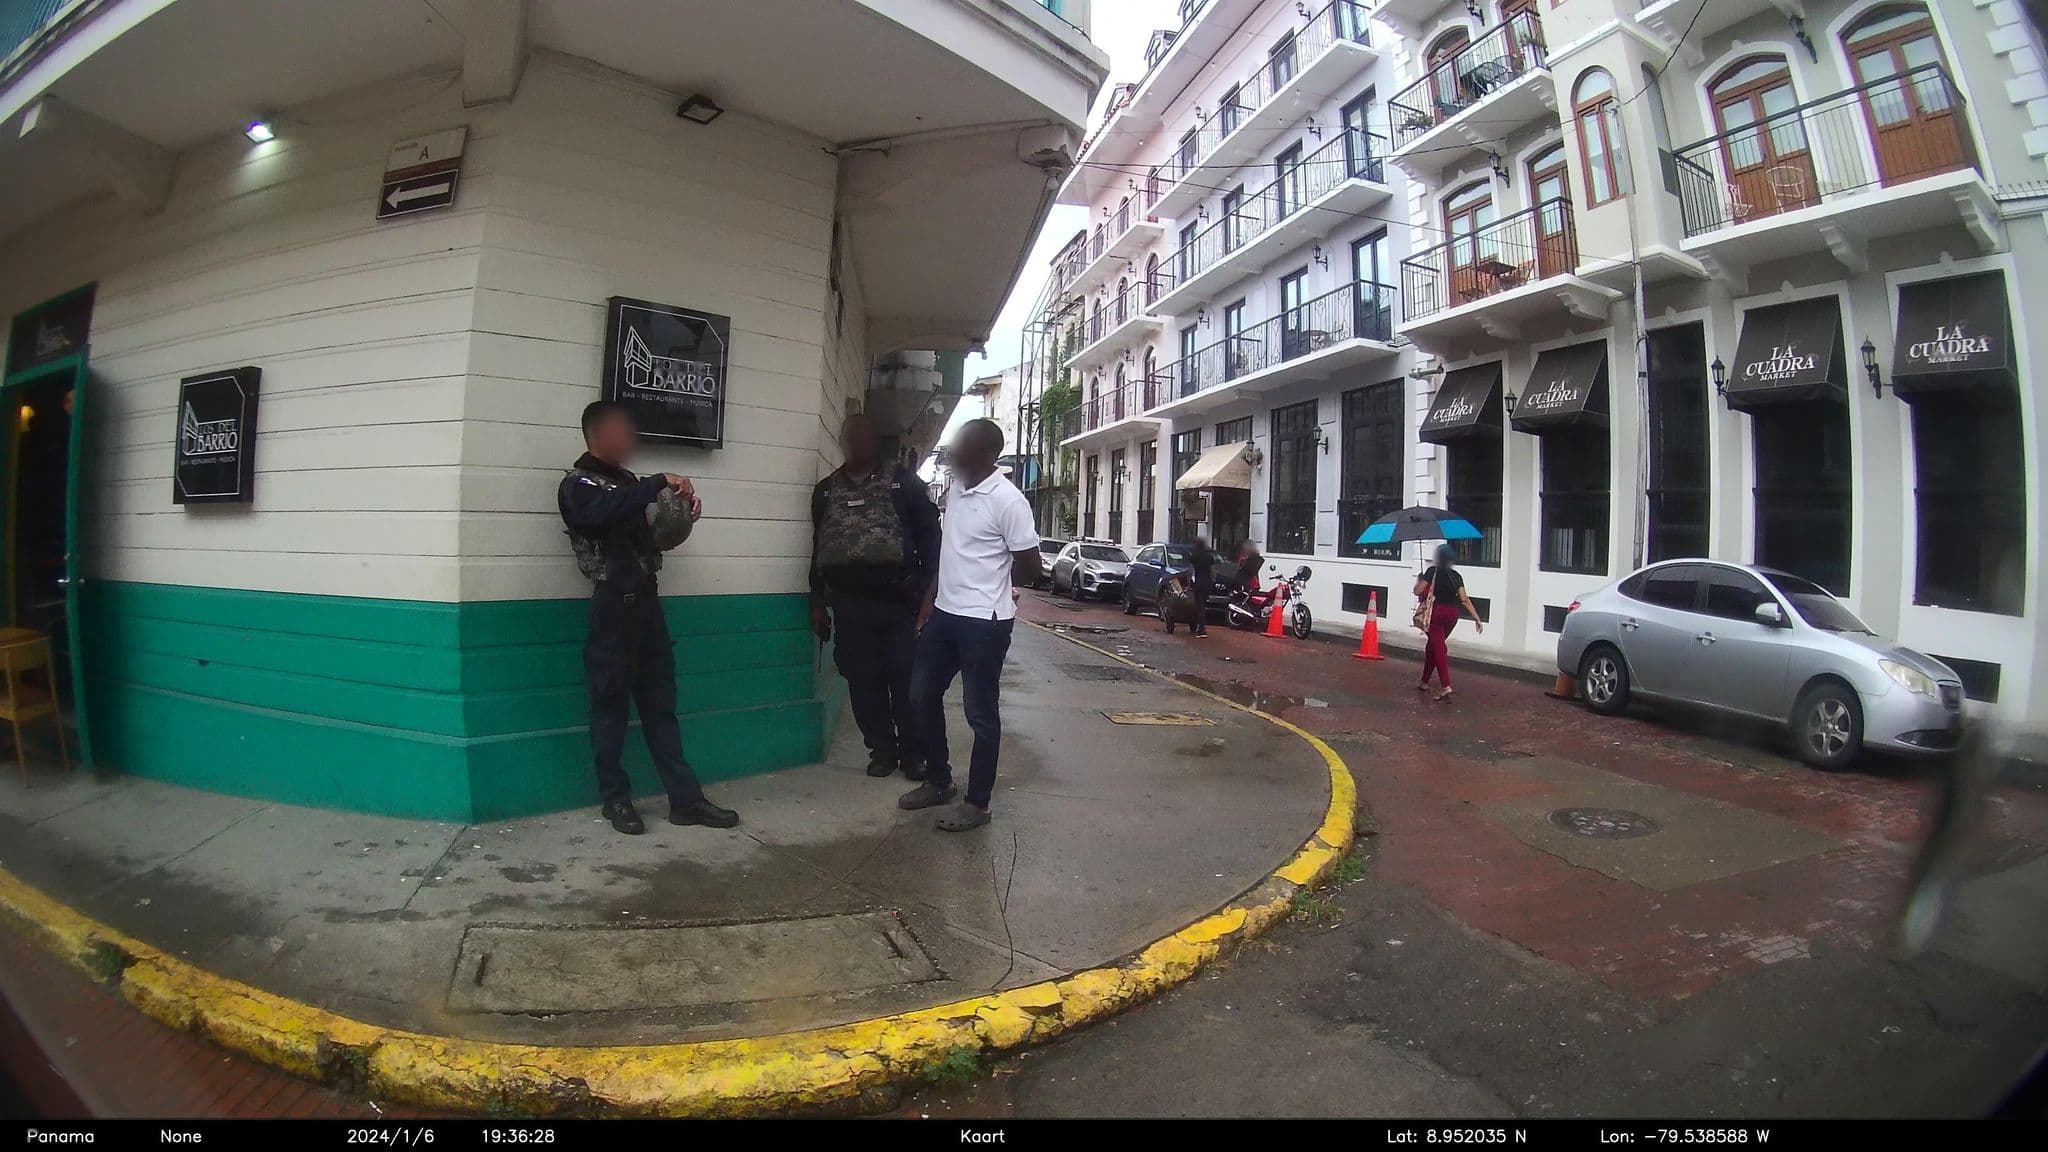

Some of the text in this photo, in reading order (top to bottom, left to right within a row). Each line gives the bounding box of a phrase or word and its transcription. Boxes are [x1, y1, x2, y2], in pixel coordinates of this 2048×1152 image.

[418, 145, 429, 160] A
[1935, 325, 1963, 341] LA
[1770, 345, 1794, 360] LA
[1909, 338, 1990, 359] CUADRA
[1745, 355, 1815, 377] CUADRA
[1759, 370, 1797, 381] MARKET
[1548, 380, 1566, 393] LA
[1450, 396, 1465, 408] LA
[1528, 389, 1578, 406] CUADRA
[1433, 405, 1474, 420] CUADRA
[197, 432, 238, 452] BARRIO
